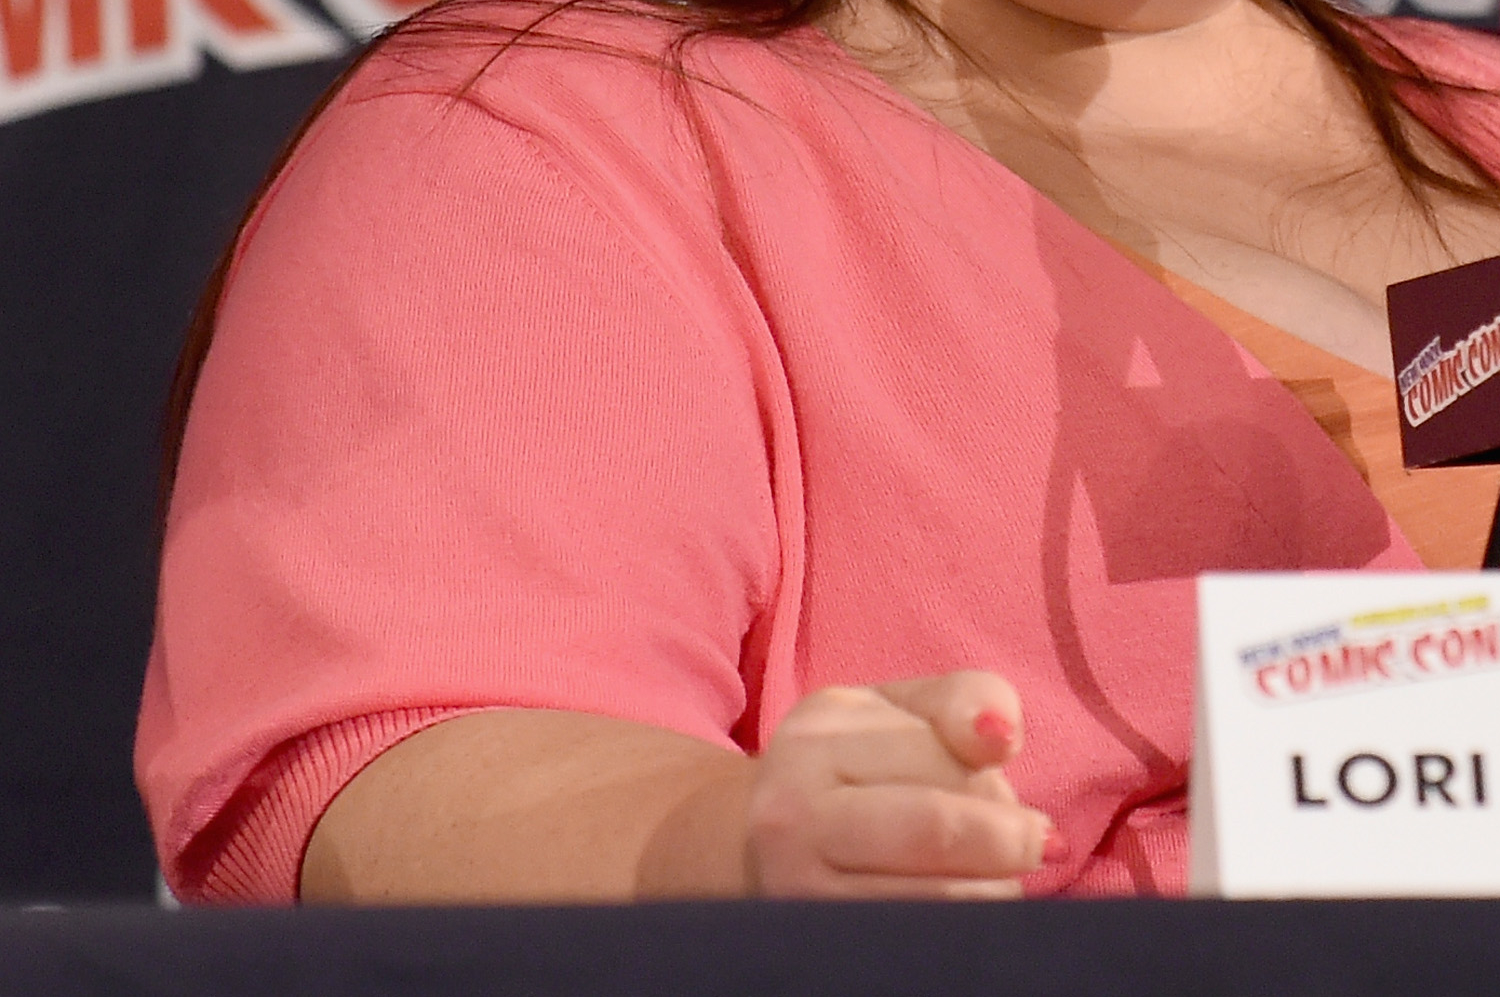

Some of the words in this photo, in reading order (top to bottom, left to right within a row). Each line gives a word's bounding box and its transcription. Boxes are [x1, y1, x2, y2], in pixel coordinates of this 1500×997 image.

[1407, 348, 1465, 420] COMIC
[1257, 640, 1393, 698] COMIC
[1291, 753, 1487, 806] LORI
